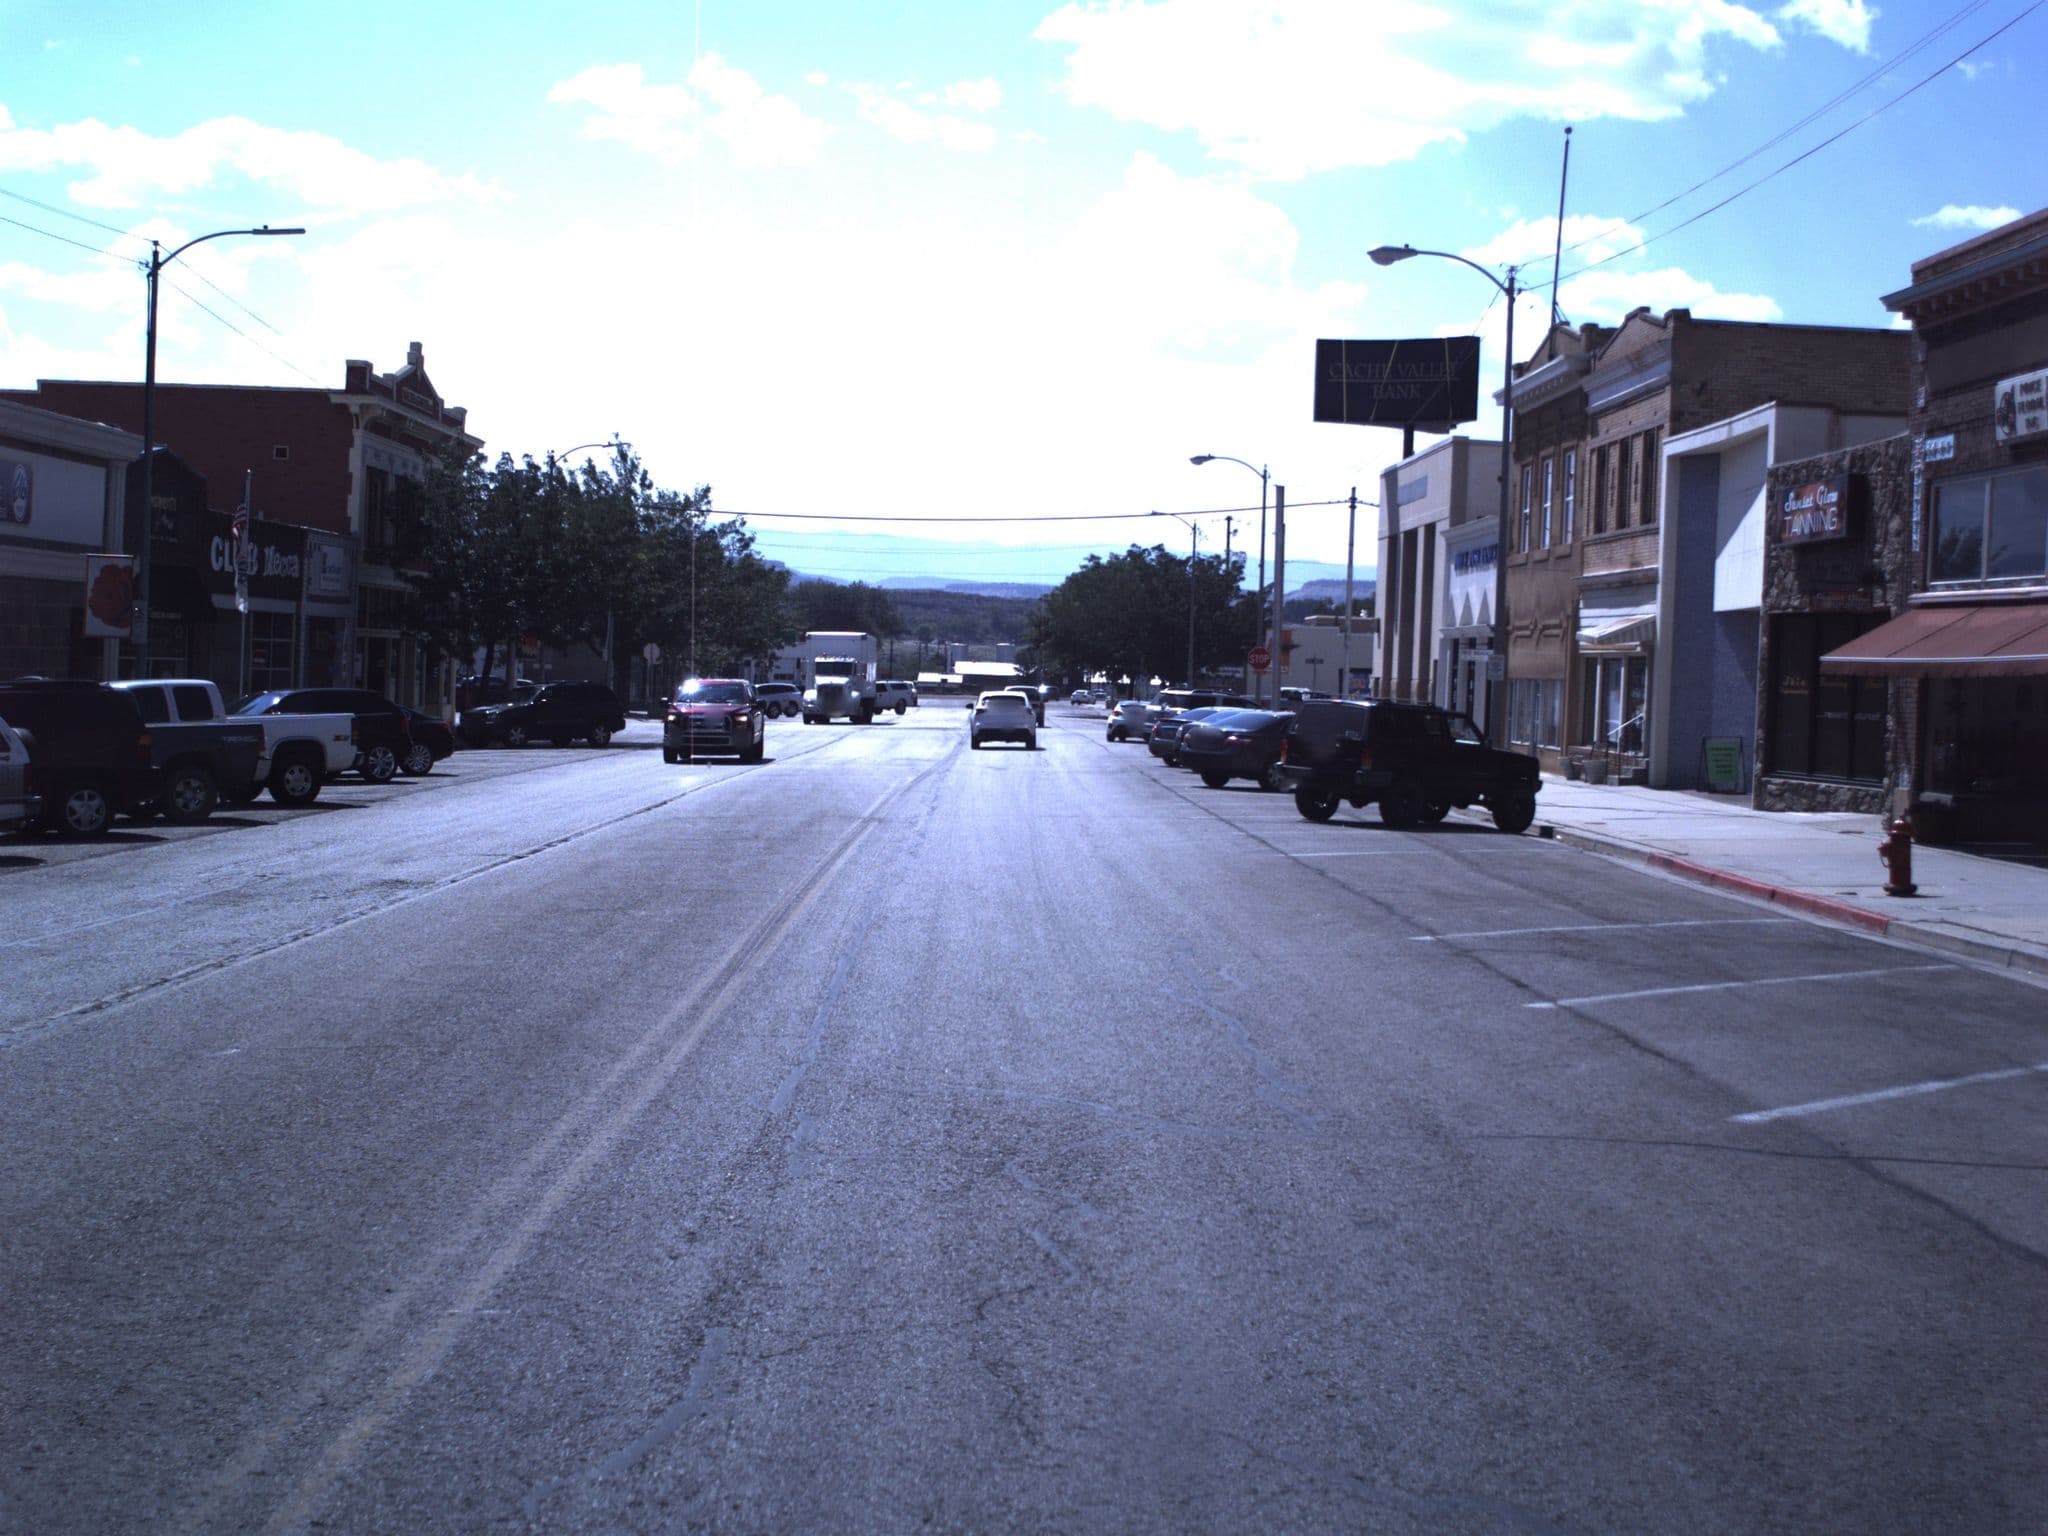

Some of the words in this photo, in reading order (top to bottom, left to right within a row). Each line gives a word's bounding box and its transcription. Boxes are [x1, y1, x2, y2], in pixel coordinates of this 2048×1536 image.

[1372, 383, 1422, 400] BANK
[1785, 491, 1813, 512] Sunset
[1784, 507, 1838, 537] TANNING
[1249, 654, 1269, 665] STOP
